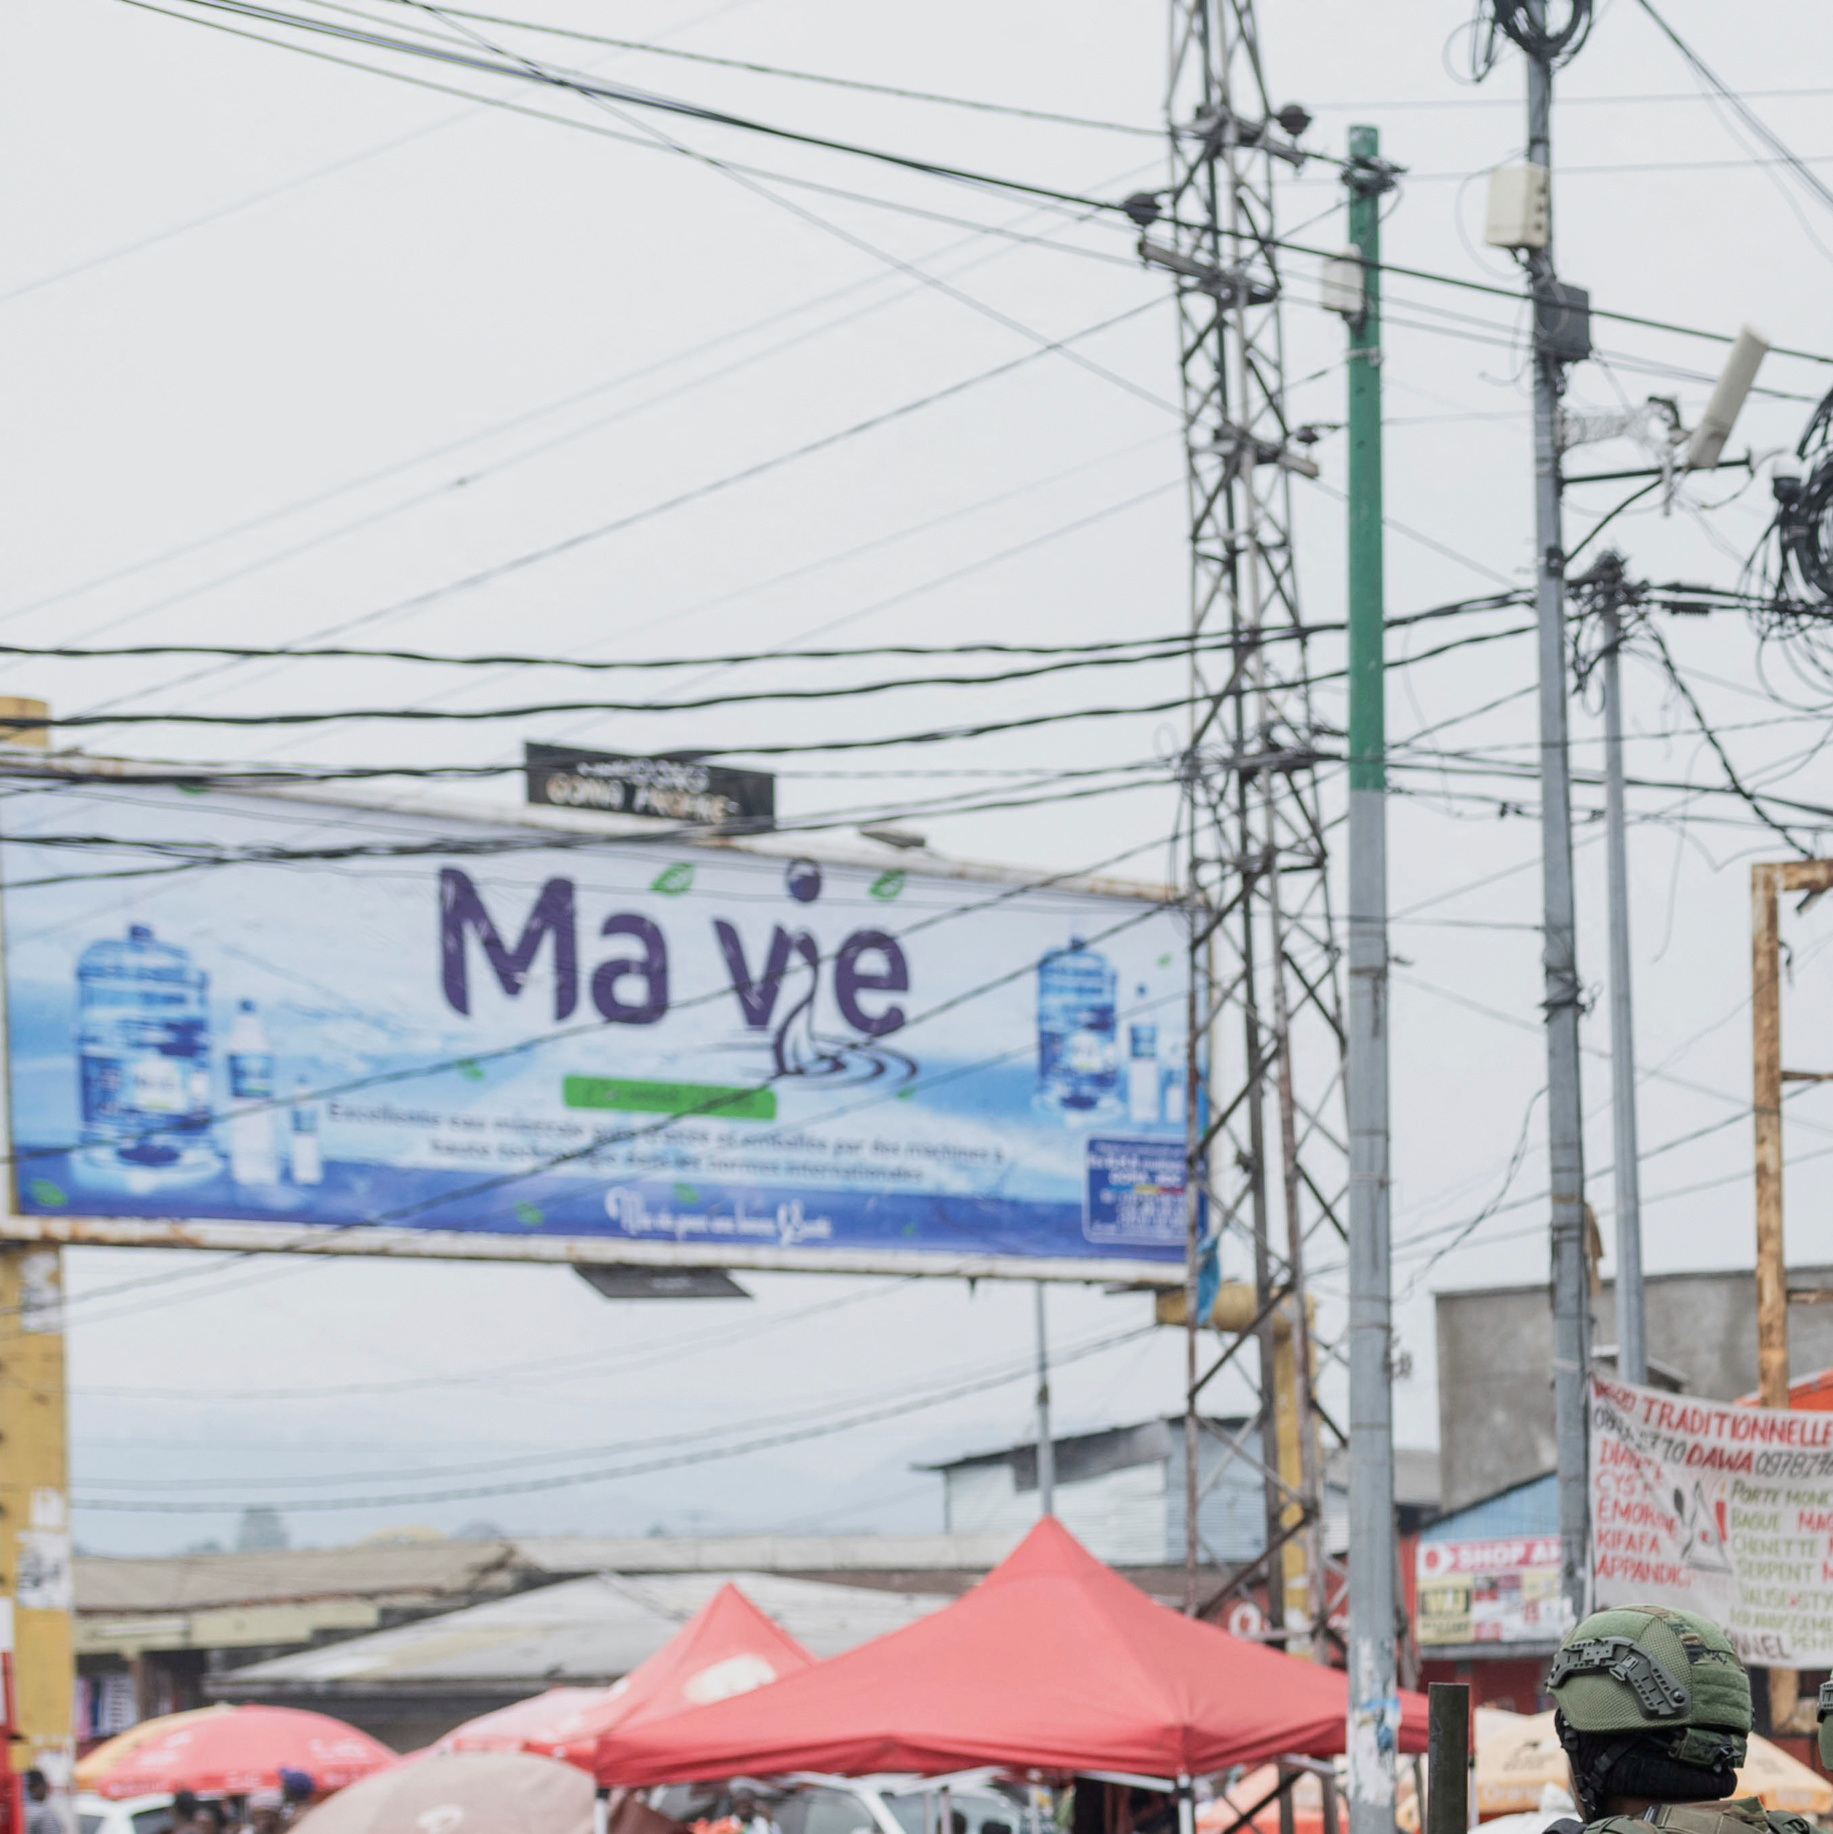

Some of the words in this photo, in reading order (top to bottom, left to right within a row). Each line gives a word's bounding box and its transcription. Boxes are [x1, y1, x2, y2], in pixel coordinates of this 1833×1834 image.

[439, 866, 670, 1026] Ma
[713, 857, 911, 1040] vie
[1641, 1396, 1831, 1448] TRADITIONNELLE
[1685, 1442, 1752, 1474] DAWA
[1458, 1540, 1527, 1568] SHOP
